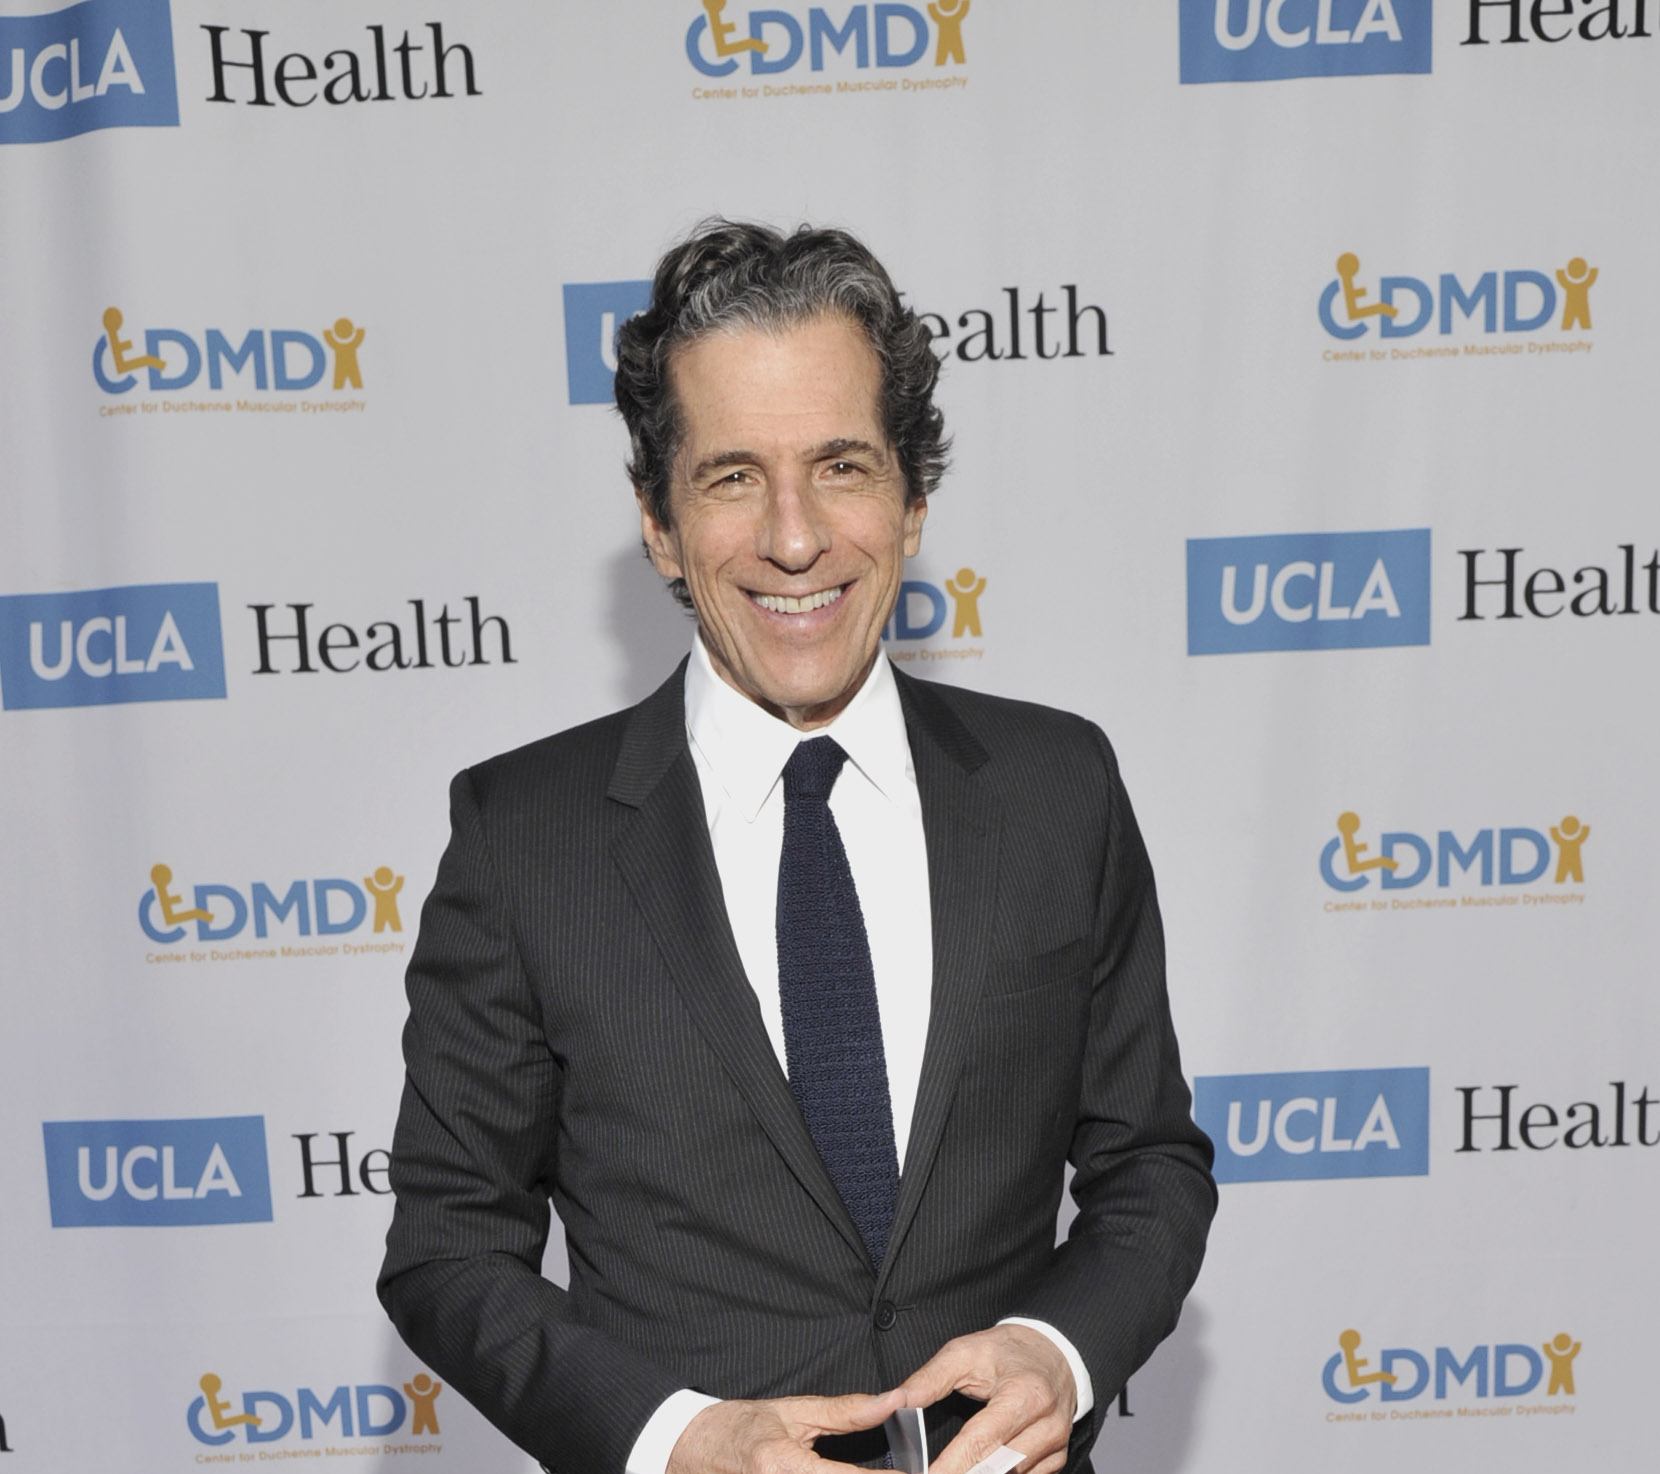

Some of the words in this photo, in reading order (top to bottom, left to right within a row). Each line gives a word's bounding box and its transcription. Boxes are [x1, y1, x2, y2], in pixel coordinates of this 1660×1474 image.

[1214, 0, 1403, 51] UCLA
[200, 22, 483, 108] Health
[692, 87, 738, 99] Center
[742, 86, 759, 97] for
[763, 84, 832, 96] Duchenne
[836, 80, 897, 92] Muscular
[902, 76, 968, 91] Dystrophy
[1322, 349, 1366, 362] Center
[1369, 348, 1387, 360] for
[1390, 347, 1459, 360] Duchenne
[1463, 344, 1524, 356] Muscular
[1527, 340, 1593, 355] Dystrophy
[99, 404, 138, 418] Center
[141, 402, 158, 413] for
[162, 400, 232, 412] Duchenne
[236, 400, 297, 412] Muscular
[301, 399, 366, 413] Dystrophy
[1220, 557, 1402, 626] UCLA
[1457, 544, 1660, 621] Healt
[29, 610, 195, 681] UCLA
[247, 596, 518, 675] Health
[1323, 901, 1368, 912] Center
[1371, 899, 1388, 910] for
[1391, 898, 1457, 910] Duchenne
[1461, 895, 1518, 907] Muscular
[1522, 892, 1585, 906] Dystrophy
[146, 952, 187, 964] Center
[190, 950, 207, 962] for
[210, 948, 277, 961] Duchenne
[280, 944, 339, 957] Muscular
[343, 942, 405, 957] Dystrophy
[1226, 1093, 1401, 1157] UCLA
[1454, 1081, 1660, 1153] Healt
[78, 1142, 242, 1201] UCLA
[1325, 1411, 1368, 1423] Center
[1370, 1410, 1387, 1421] for
[1390, 1409, 1454, 1421] Duchenne
[1457, 1406, 1513, 1418] Muscular
[1516, 1403, 1576, 1417] Dystrophy
[195, 1453, 236, 1465] Center
[239, 1452, 256, 1463] for
[258, 1447, 322, 1461] Duchenne
[325, 1445, 380, 1458] Muscular
[383, 1443, 443, 1457] Dystrophy
